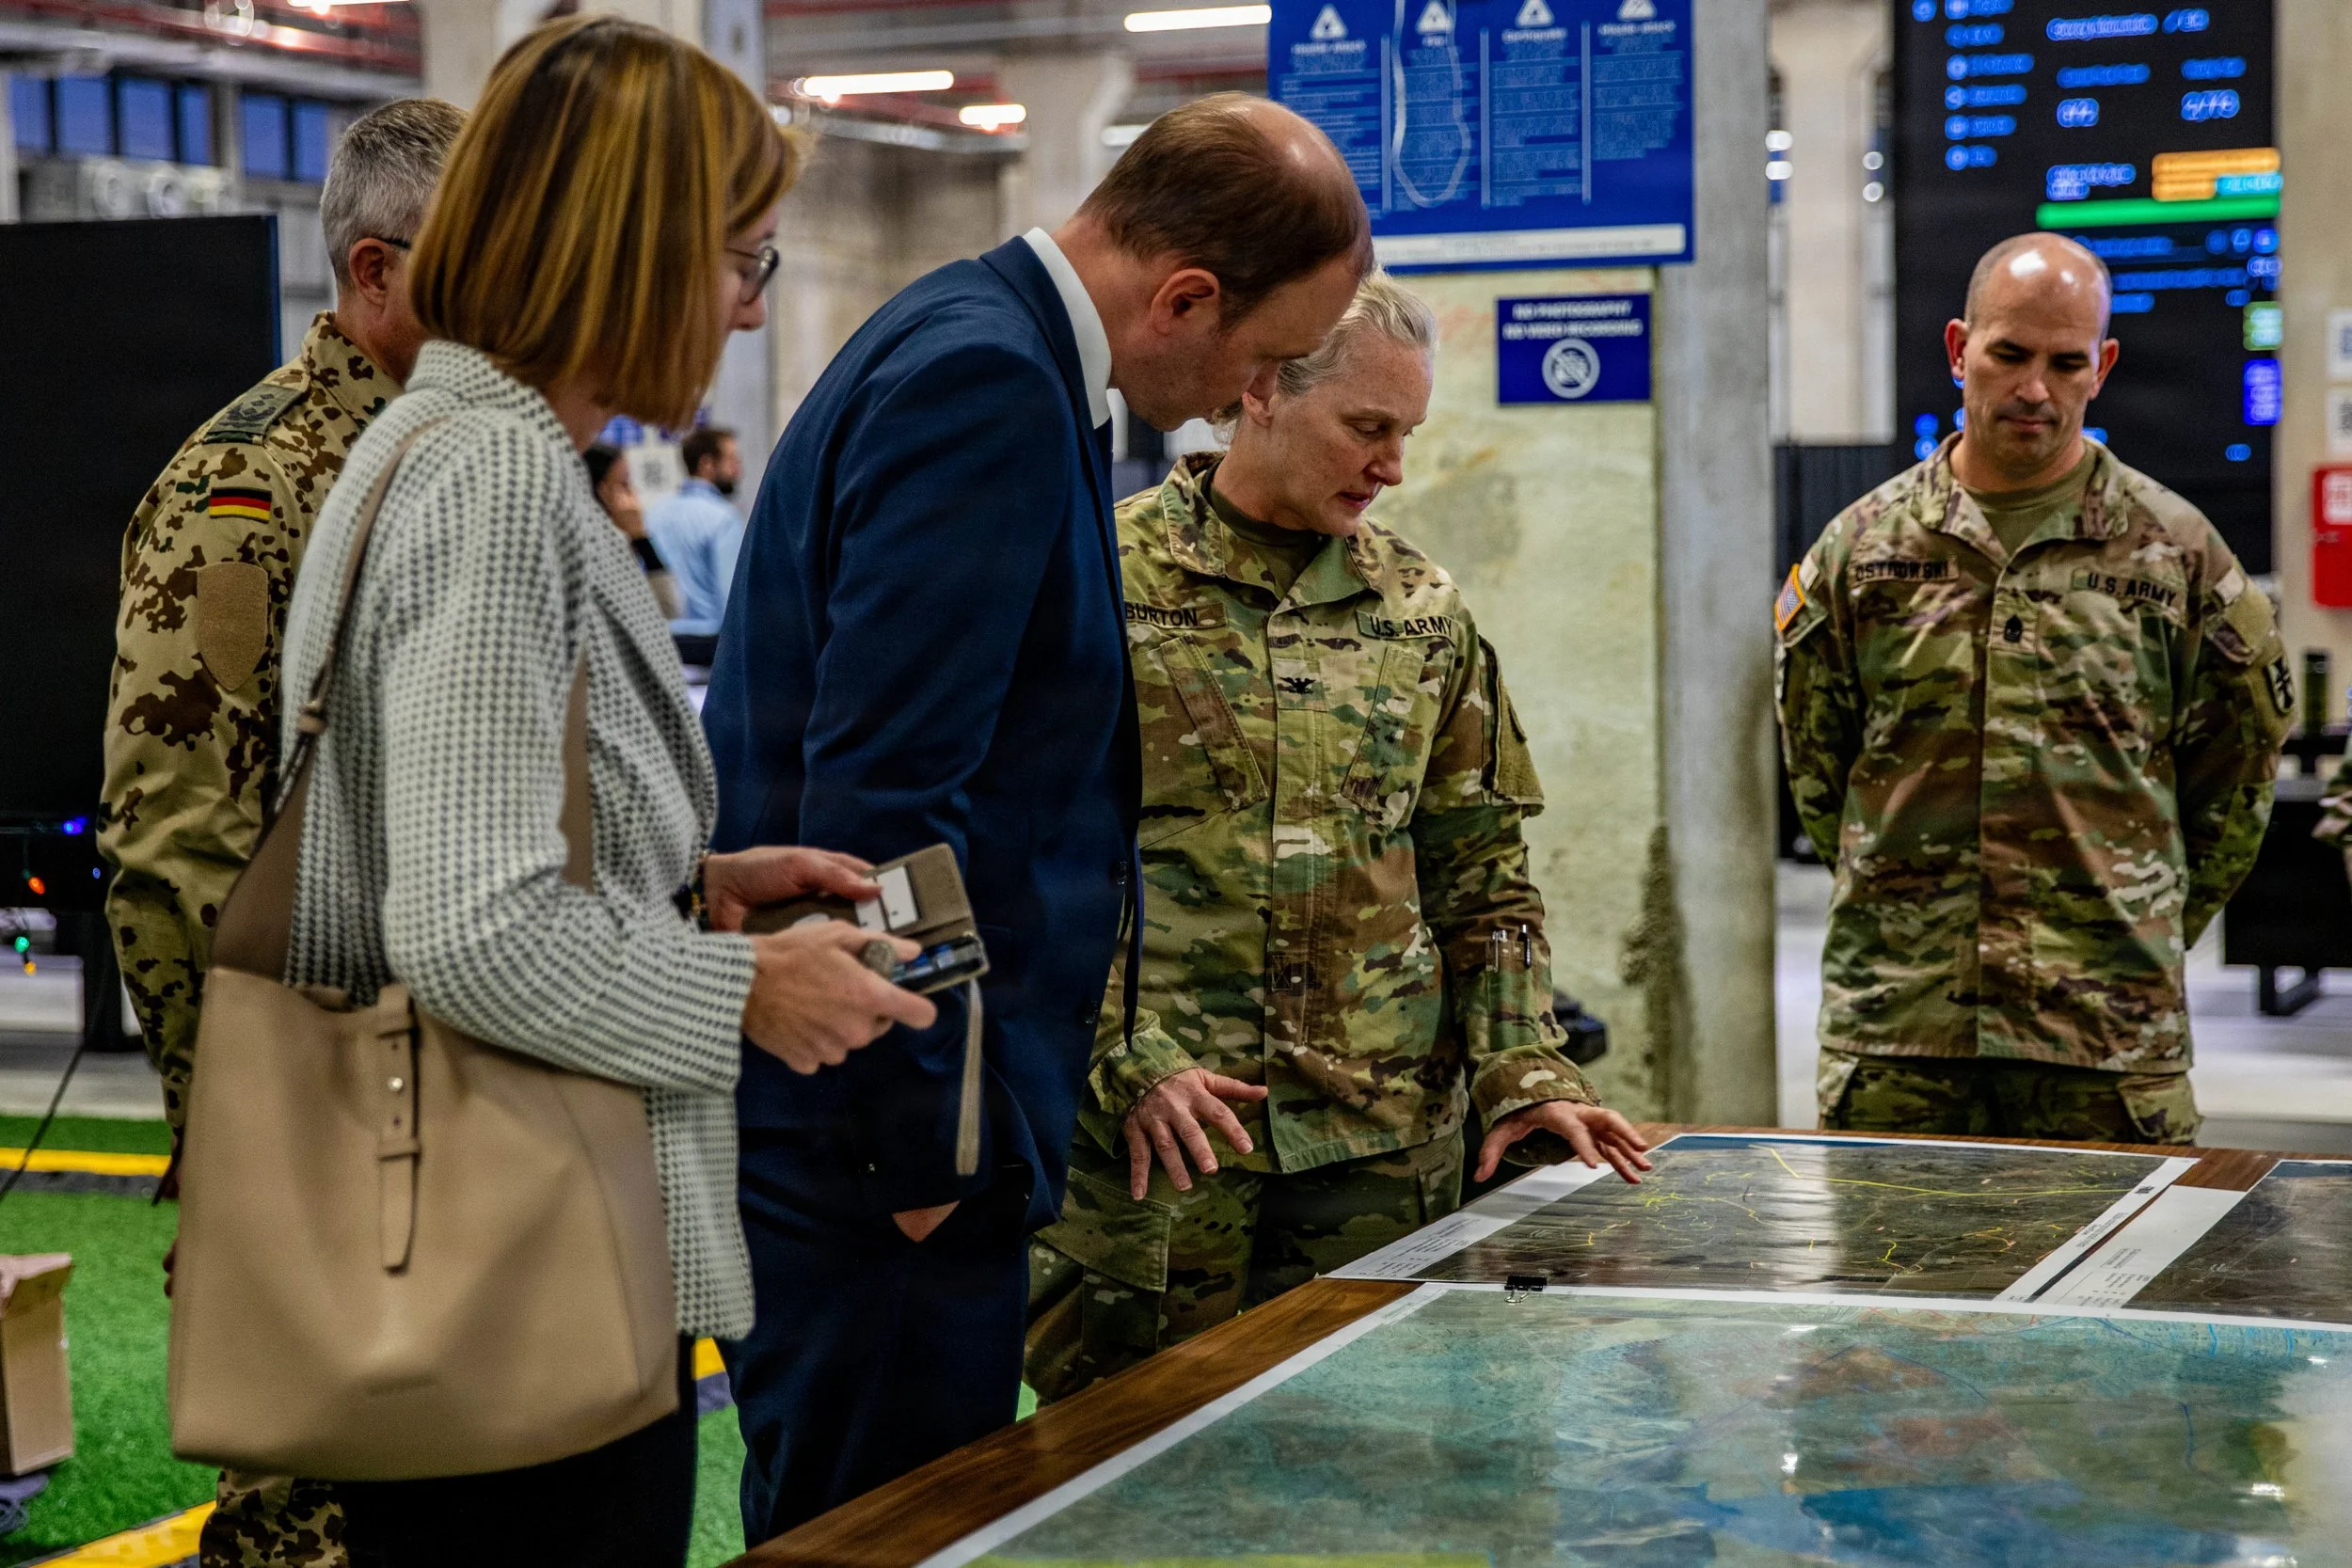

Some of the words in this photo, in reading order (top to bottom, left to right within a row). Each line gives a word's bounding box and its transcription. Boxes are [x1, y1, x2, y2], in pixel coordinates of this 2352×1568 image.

[2123, 578, 2177, 608] ARMY
[1125, 602, 1199, 627] BURTON
[1370, 615, 1399, 638] U.S.
[1403, 615, 1453, 638] ARMY
